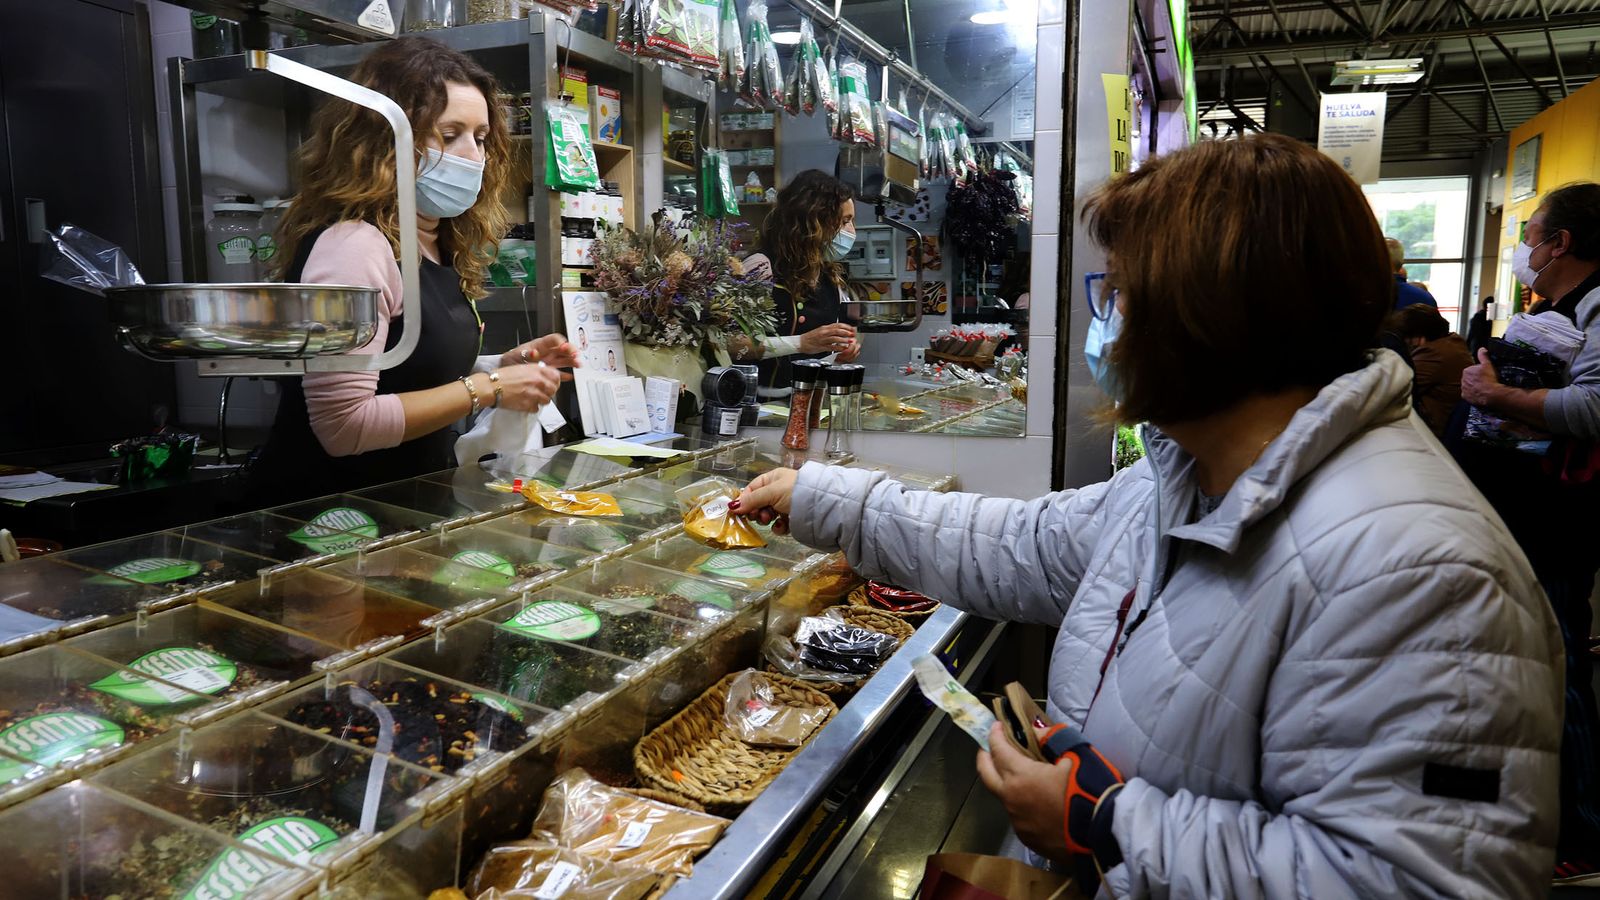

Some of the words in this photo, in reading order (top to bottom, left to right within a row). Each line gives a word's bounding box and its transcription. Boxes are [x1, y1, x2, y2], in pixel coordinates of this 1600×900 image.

[1339, 110, 1376, 118] SALUDA
[515, 602, 584, 626] ESSENTIA
[119, 650, 220, 682] ESSENTIA
[0, 715, 105, 755] SSENTIA
